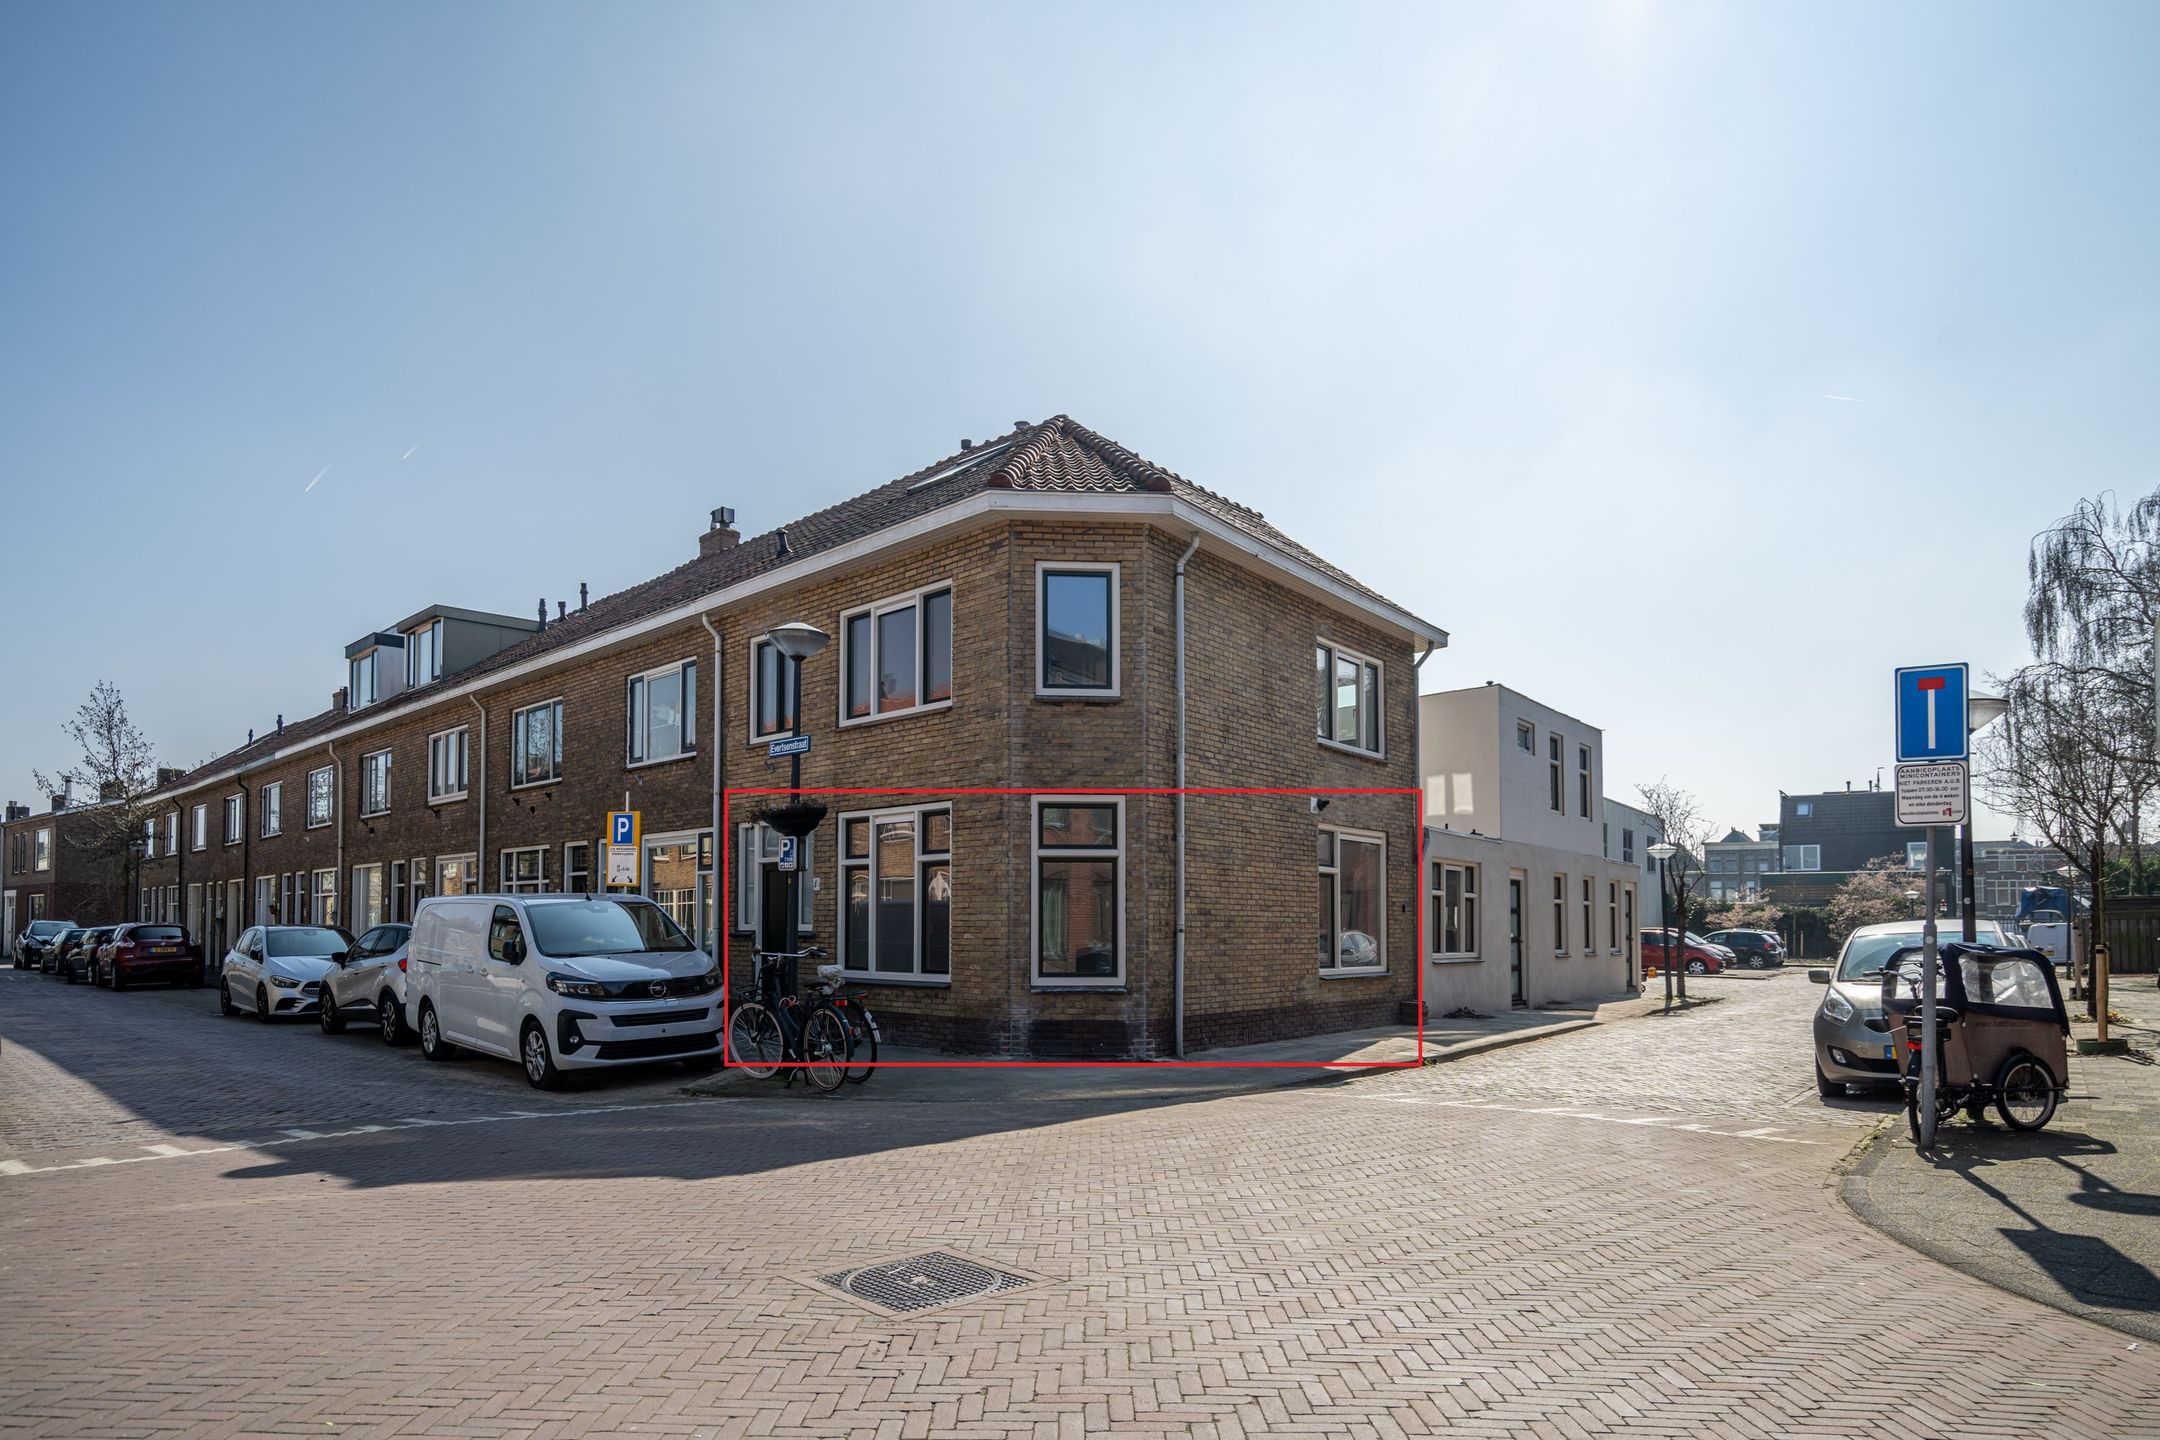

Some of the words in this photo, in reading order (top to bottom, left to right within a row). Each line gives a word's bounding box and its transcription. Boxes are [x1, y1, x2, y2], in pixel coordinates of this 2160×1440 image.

[771, 739, 807, 753] Evertsenstraat
[1900, 766, 1960, 774] AANBIEDPLAATS
[617, 817, 630, 842] P
[780, 839, 791, 858] P
